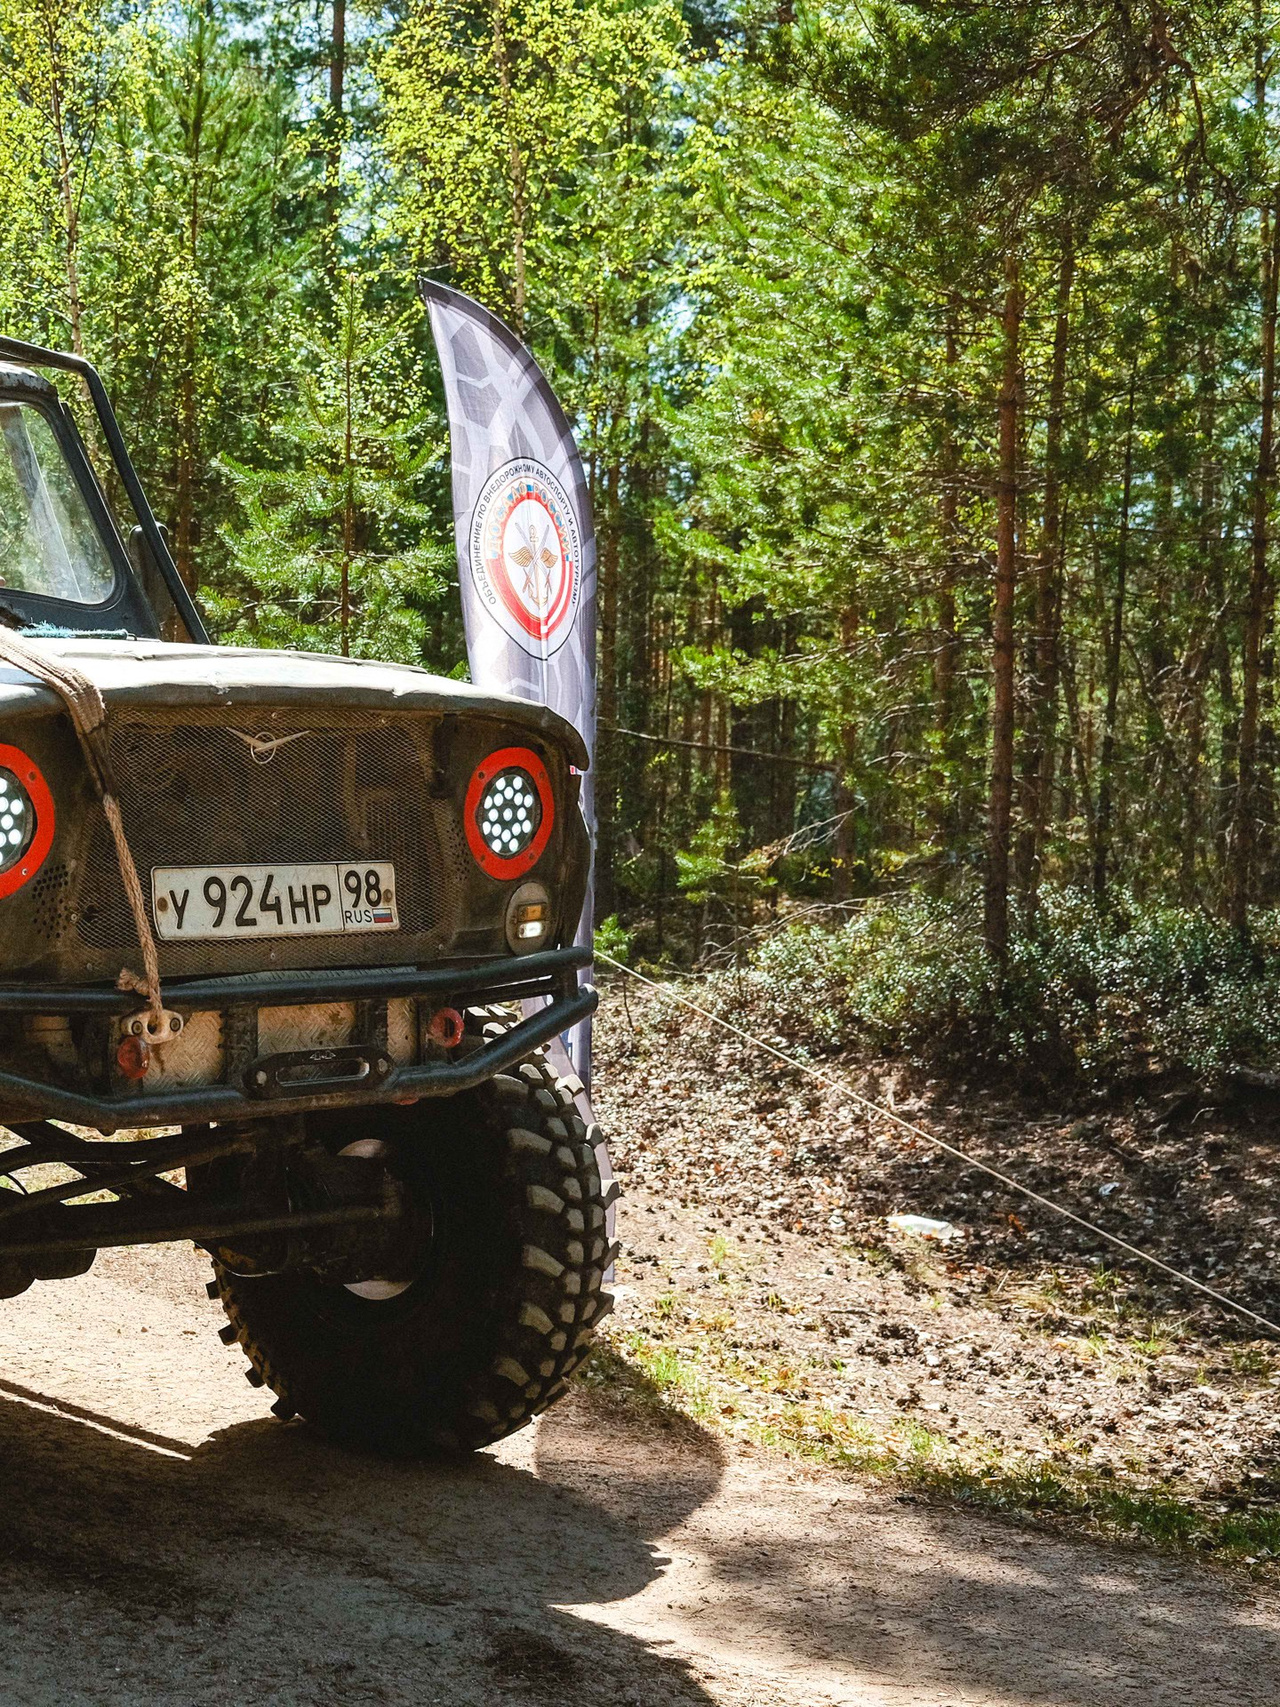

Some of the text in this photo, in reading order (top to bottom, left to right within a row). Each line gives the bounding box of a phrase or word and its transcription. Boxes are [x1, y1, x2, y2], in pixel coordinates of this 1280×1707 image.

[483, 463, 535, 504] ВНЕДОРОЖНОМУ
[536, 468, 571, 515] АВТОСПОРТУ
[477, 503, 487, 519] ПО
[487, 481, 570, 559] ДОСААФ РОССИИ
[473, 519, 497, 606] ОБЪЕДИНЕНИЕ
[570, 529, 580, 608] АВТОТУРИЗМУ
[344, 870, 382, 908] 98
[345, 909, 373, 925] RUS
